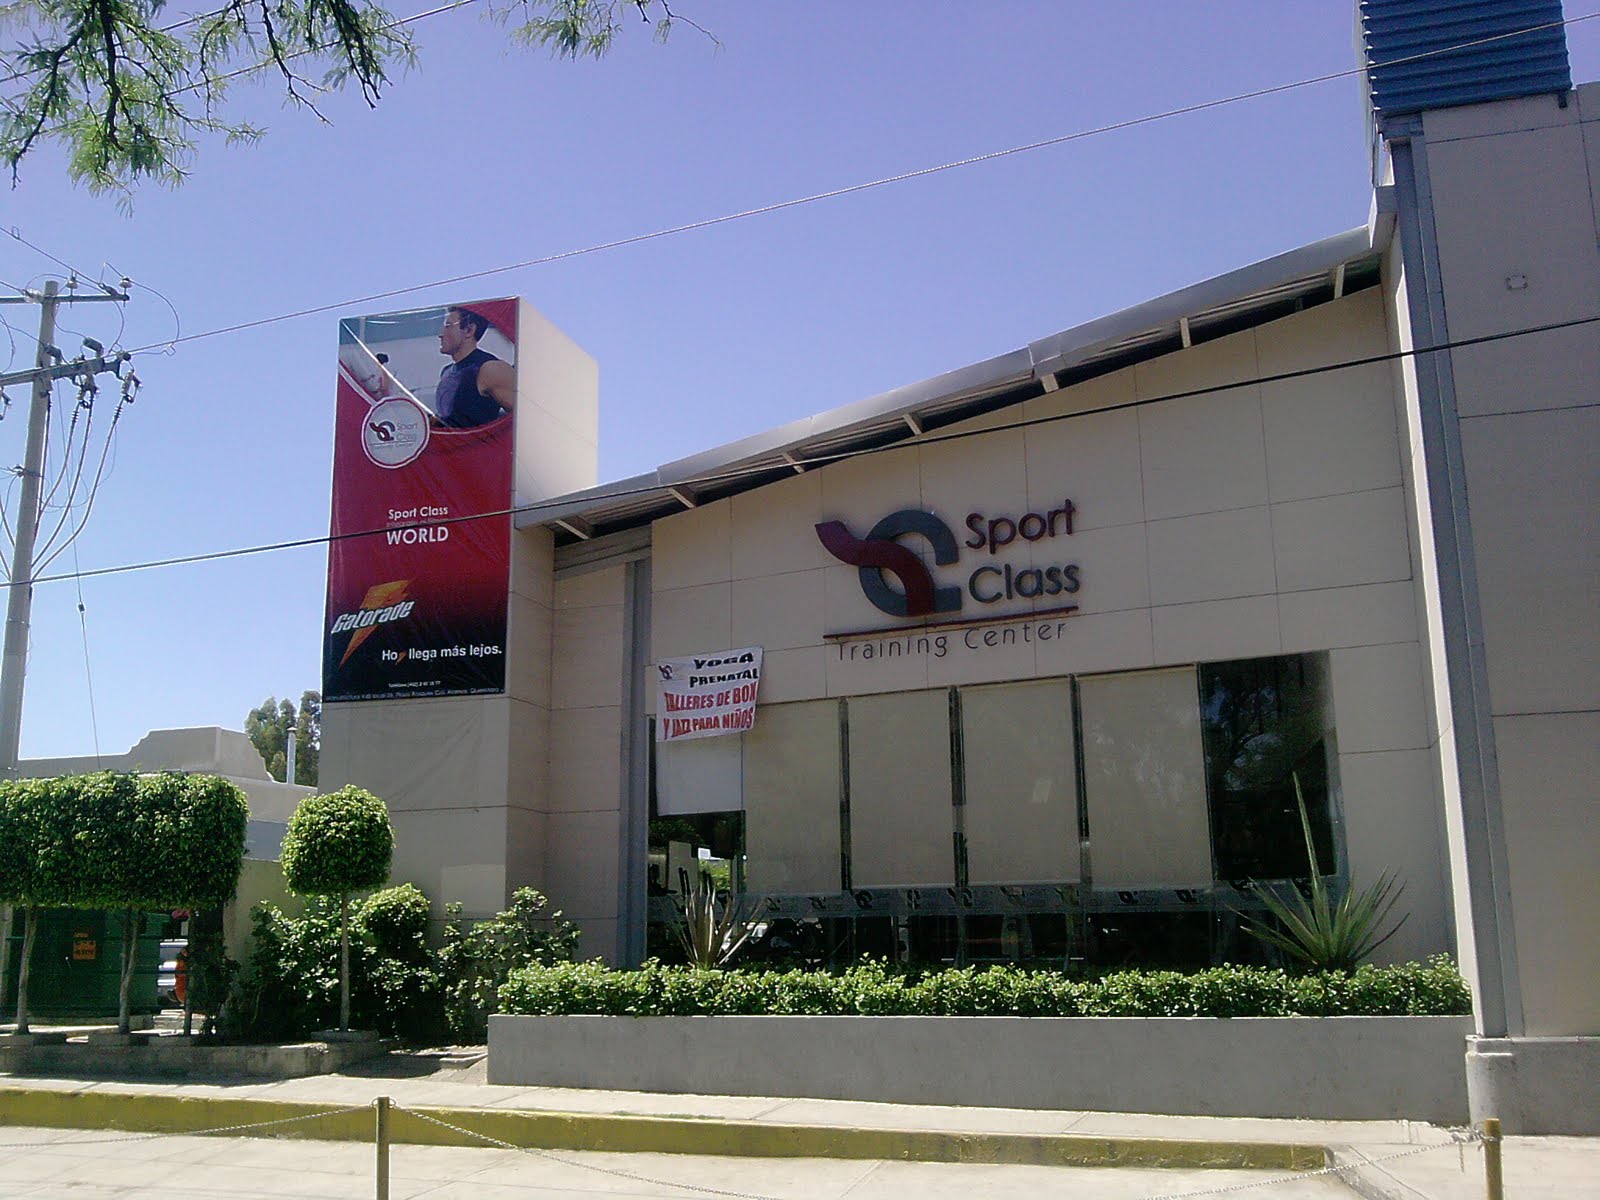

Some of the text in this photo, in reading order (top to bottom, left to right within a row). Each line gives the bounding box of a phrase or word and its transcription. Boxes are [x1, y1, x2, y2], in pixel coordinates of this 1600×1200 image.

[388, 505, 449, 521] Sport Class
[386, 526, 449, 545] WORLD
[965, 499, 1077, 555] Sport
[968, 564, 1081, 604] Class
[331, 600, 415, 634] Gatorade
[408, 647, 437, 661] llega
[440, 645, 467, 658] más
[469, 643, 502, 658] lejos.
[837, 621, 1066, 661] Training Center
[693, 652, 754, 669] YOGA
[689, 667, 759, 688] PRENATAL
[664, 692, 714, 712] TALLERES
[716, 690, 731, 707] DE
[692, 715, 720, 732] PARA
[722, 706, 754, 729] NIÑOS
